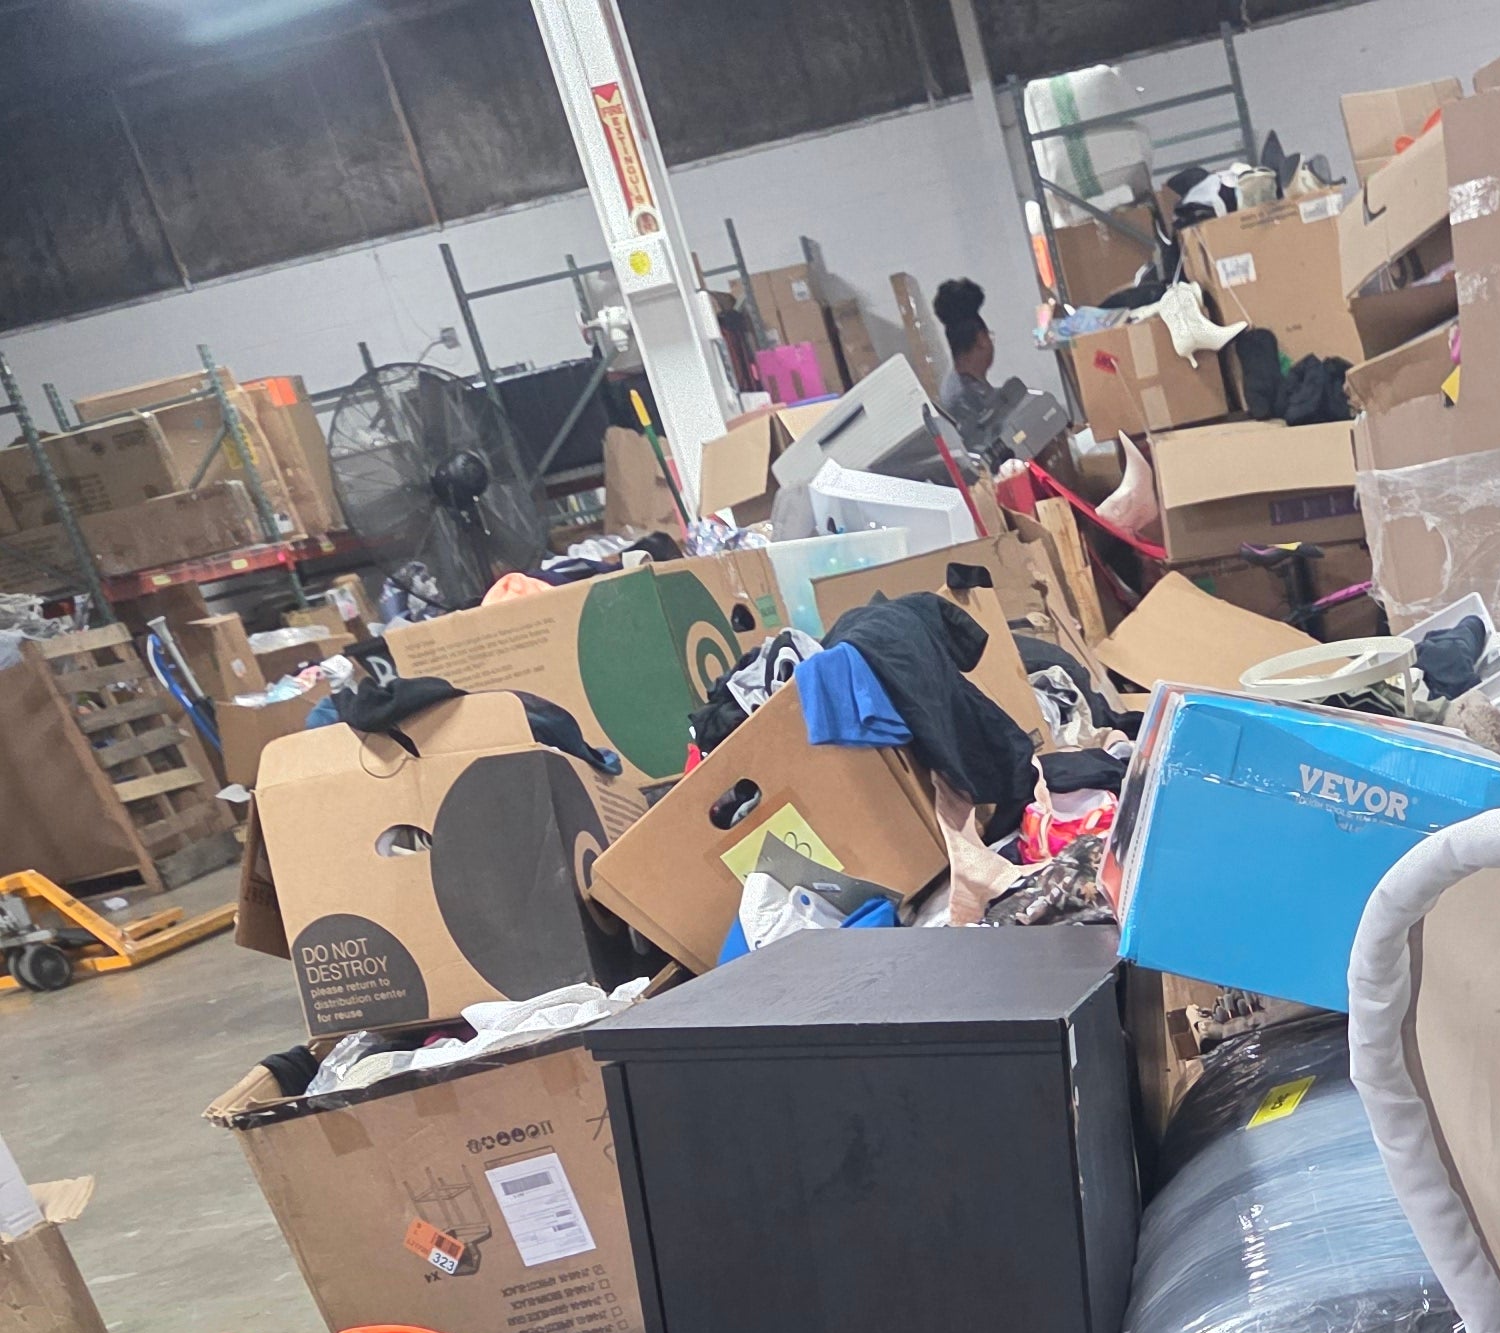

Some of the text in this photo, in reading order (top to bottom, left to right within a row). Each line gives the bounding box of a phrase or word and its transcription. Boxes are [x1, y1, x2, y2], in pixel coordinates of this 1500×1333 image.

[1299, 763, 1409, 822] VEVOR
[302, 938, 368, 965] DO NOT
[306, 955, 388, 984] DESTROY
[310, 977, 391, 998] please return to
[314, 988, 407, 1011] distribution center
[316, 1008, 363, 1023] for reuse
[432, 1250, 455, 1272] 323
